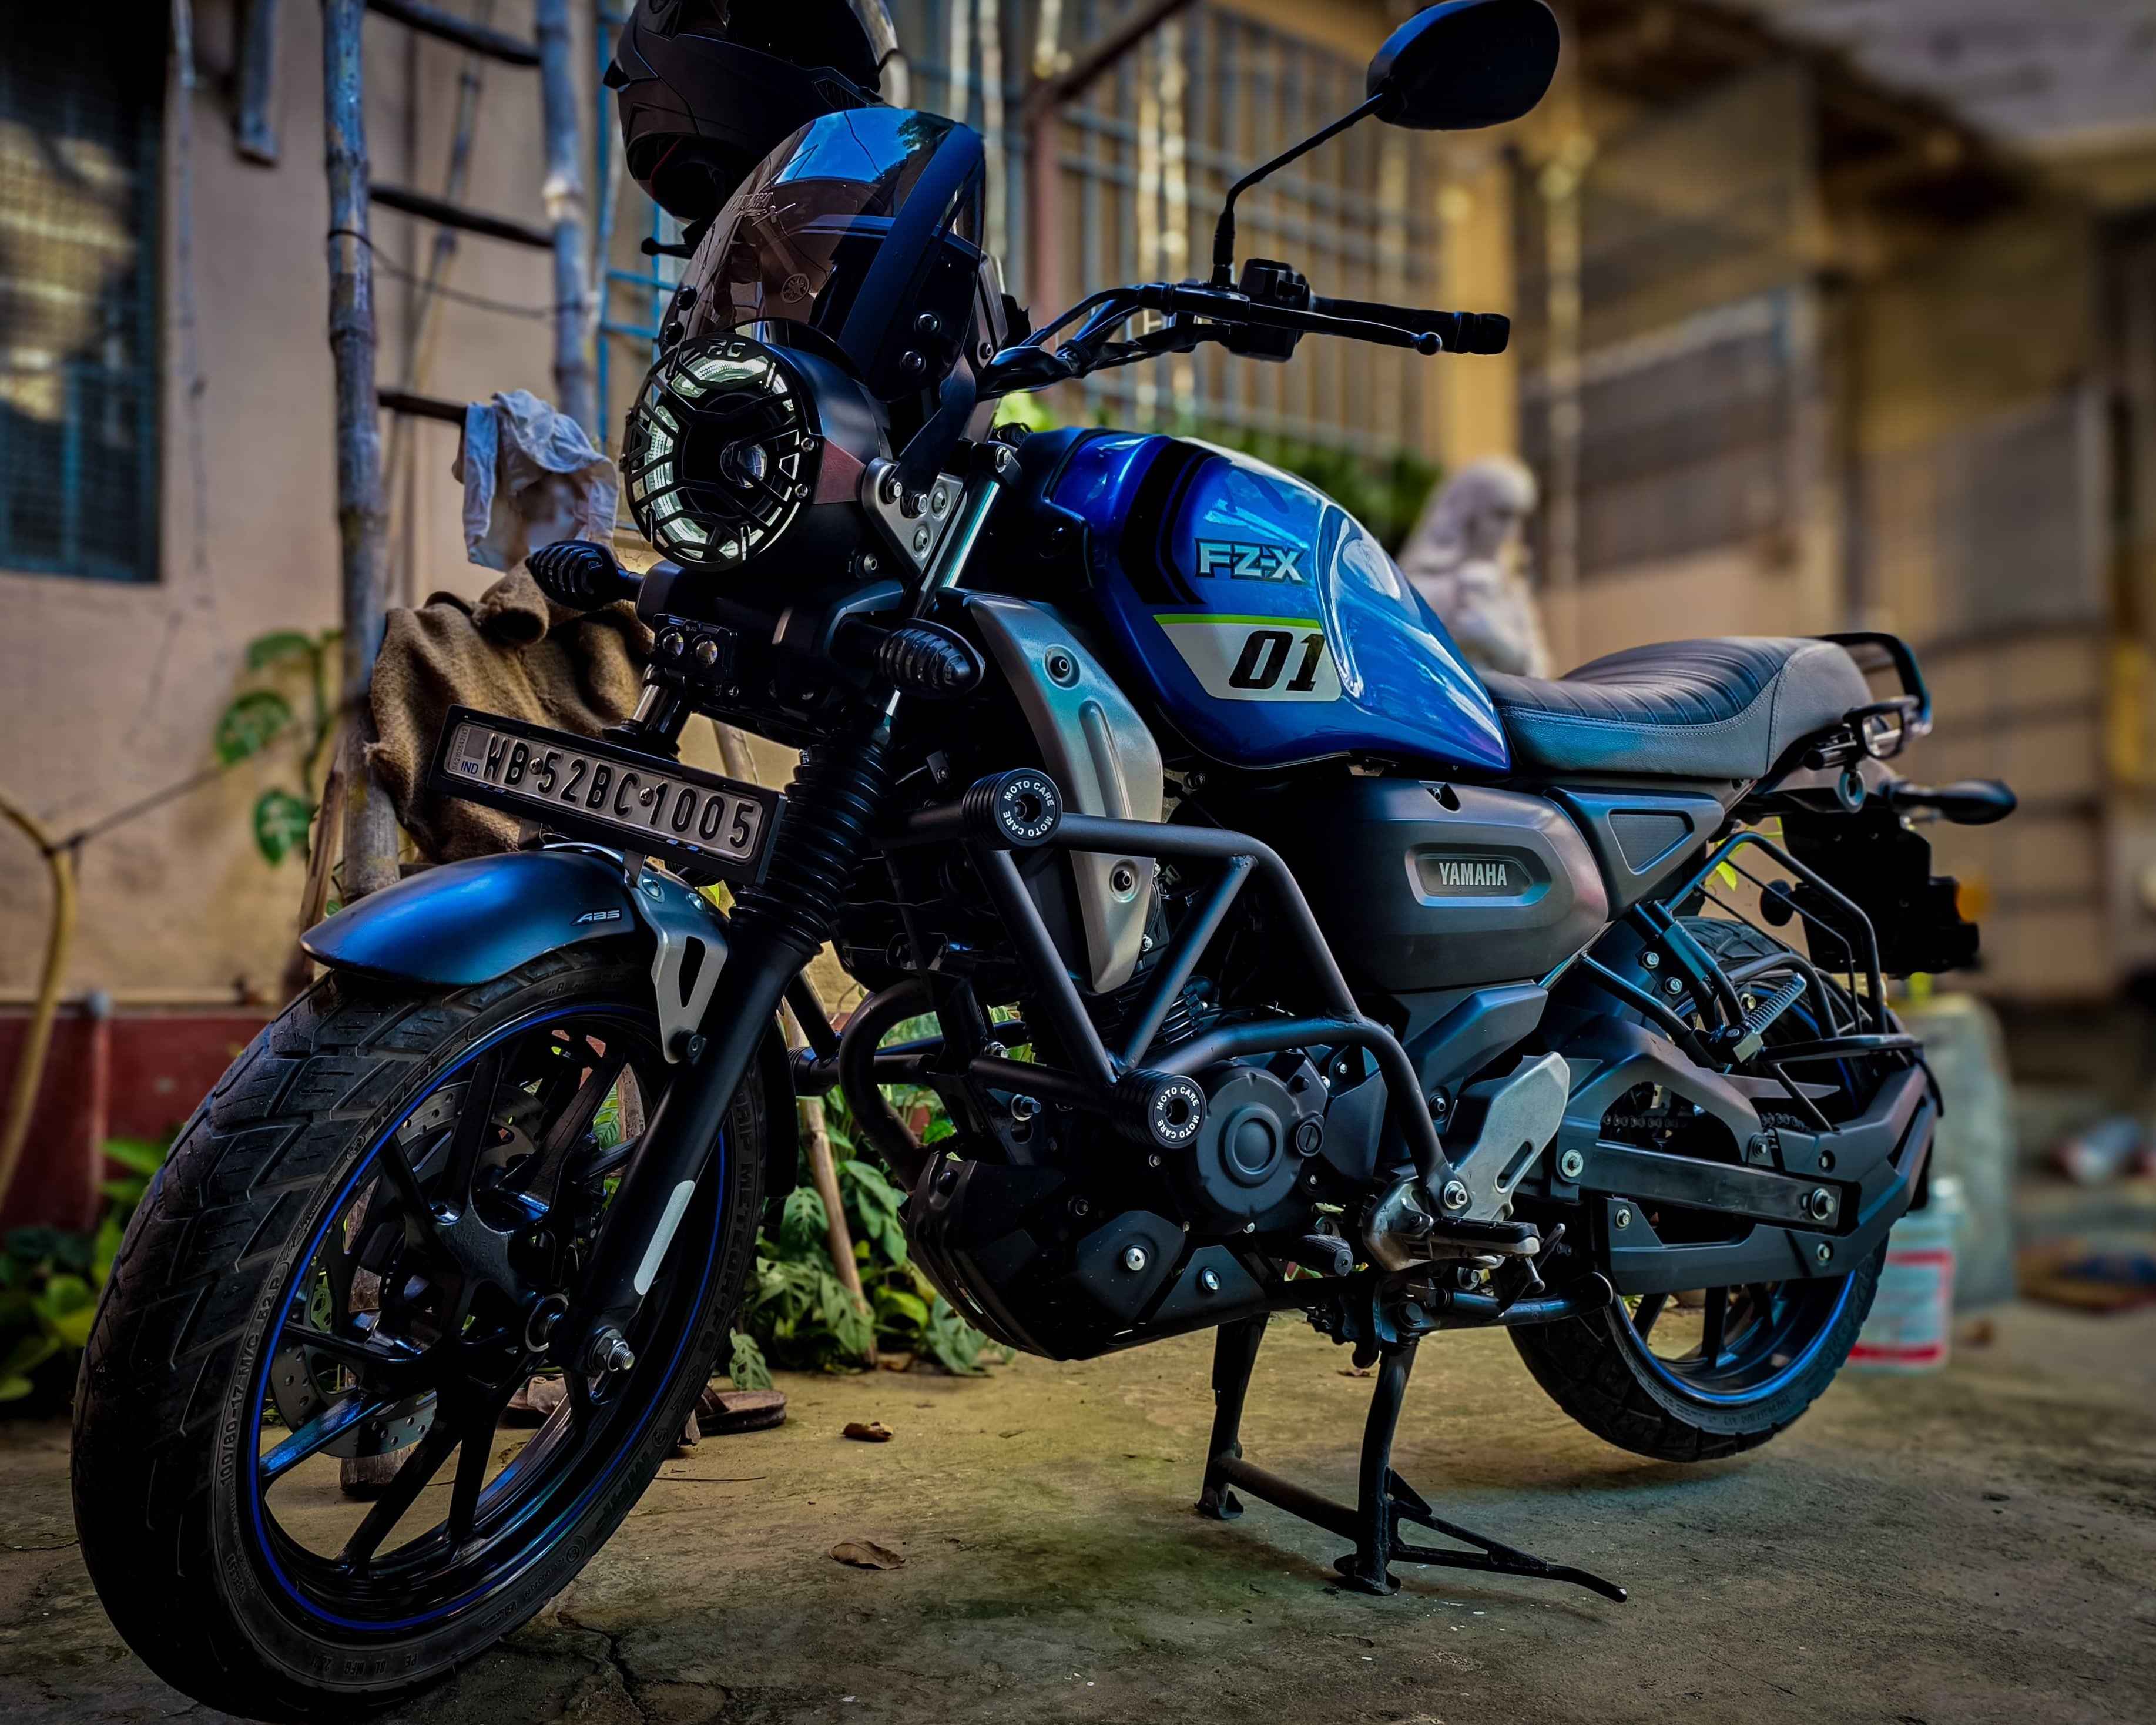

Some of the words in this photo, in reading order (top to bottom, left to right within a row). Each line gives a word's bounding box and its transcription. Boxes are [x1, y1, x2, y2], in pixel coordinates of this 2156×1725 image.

[1196, 539, 1306, 584] FZ-X
[1228, 630, 1326, 692] 01
[460, 760, 479, 775] IND
[1004, 780, 1030, 801] MOTO
[1034, 782, 1055, 807] CARE
[1003, 810, 1024, 835] CARE
[1028, 816, 1054, 837] MOTO
[1439, 862, 1508, 886] YAMAHA
[576, 909, 620, 923] ABS
[1156, 1087, 1177, 1110] MOTO
[1180, 1087, 1199, 1106] CARE
[1157, 1119, 1176, 1138] CARE
[1179, 1115, 1199, 1138] MOTO
